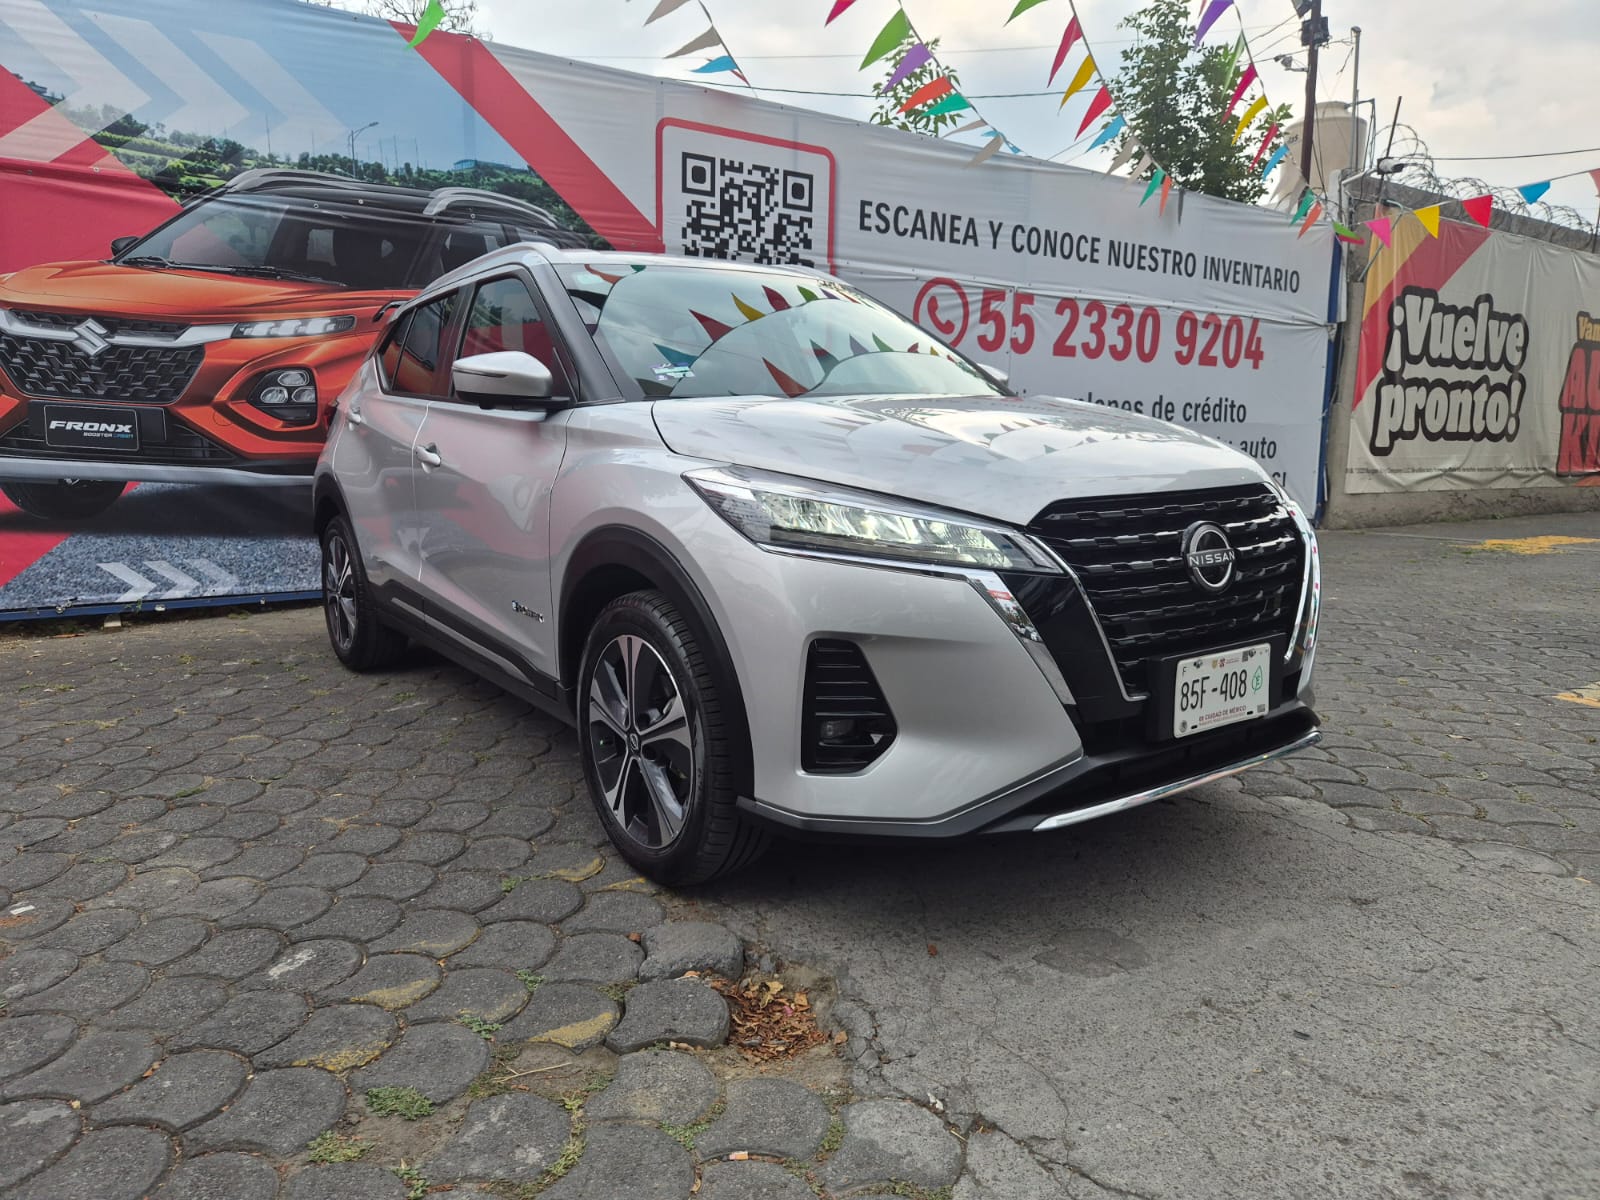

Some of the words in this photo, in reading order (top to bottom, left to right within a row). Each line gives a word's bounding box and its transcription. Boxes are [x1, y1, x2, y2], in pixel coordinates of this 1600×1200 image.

[859, 200, 979, 247] ESCANEA
[988, 221, 1004, 249] Y
[1011, 224, 1101, 264] CONOCE
[1107, 240, 1197, 278] NUESTRO
[1203, 256, 1300, 293] INVENTARIO
[977, 288, 1035, 355] 55
[1053, 297, 1161, 363] 2330
[1175, 310, 1264, 370] 9204
[1384, 288, 1528, 375] ¡Vuelve
[49, 420, 132, 432] FRONX
[1152, 394, 1175, 422] de
[1182, 396, 1247, 423] crédito
[1372, 376, 1525, 453] pronto!
[1240, 436, 1277, 459] auto
[1189, 551, 1235, 566] NISSAN
[1180, 669, 1248, 712] 85F-408
